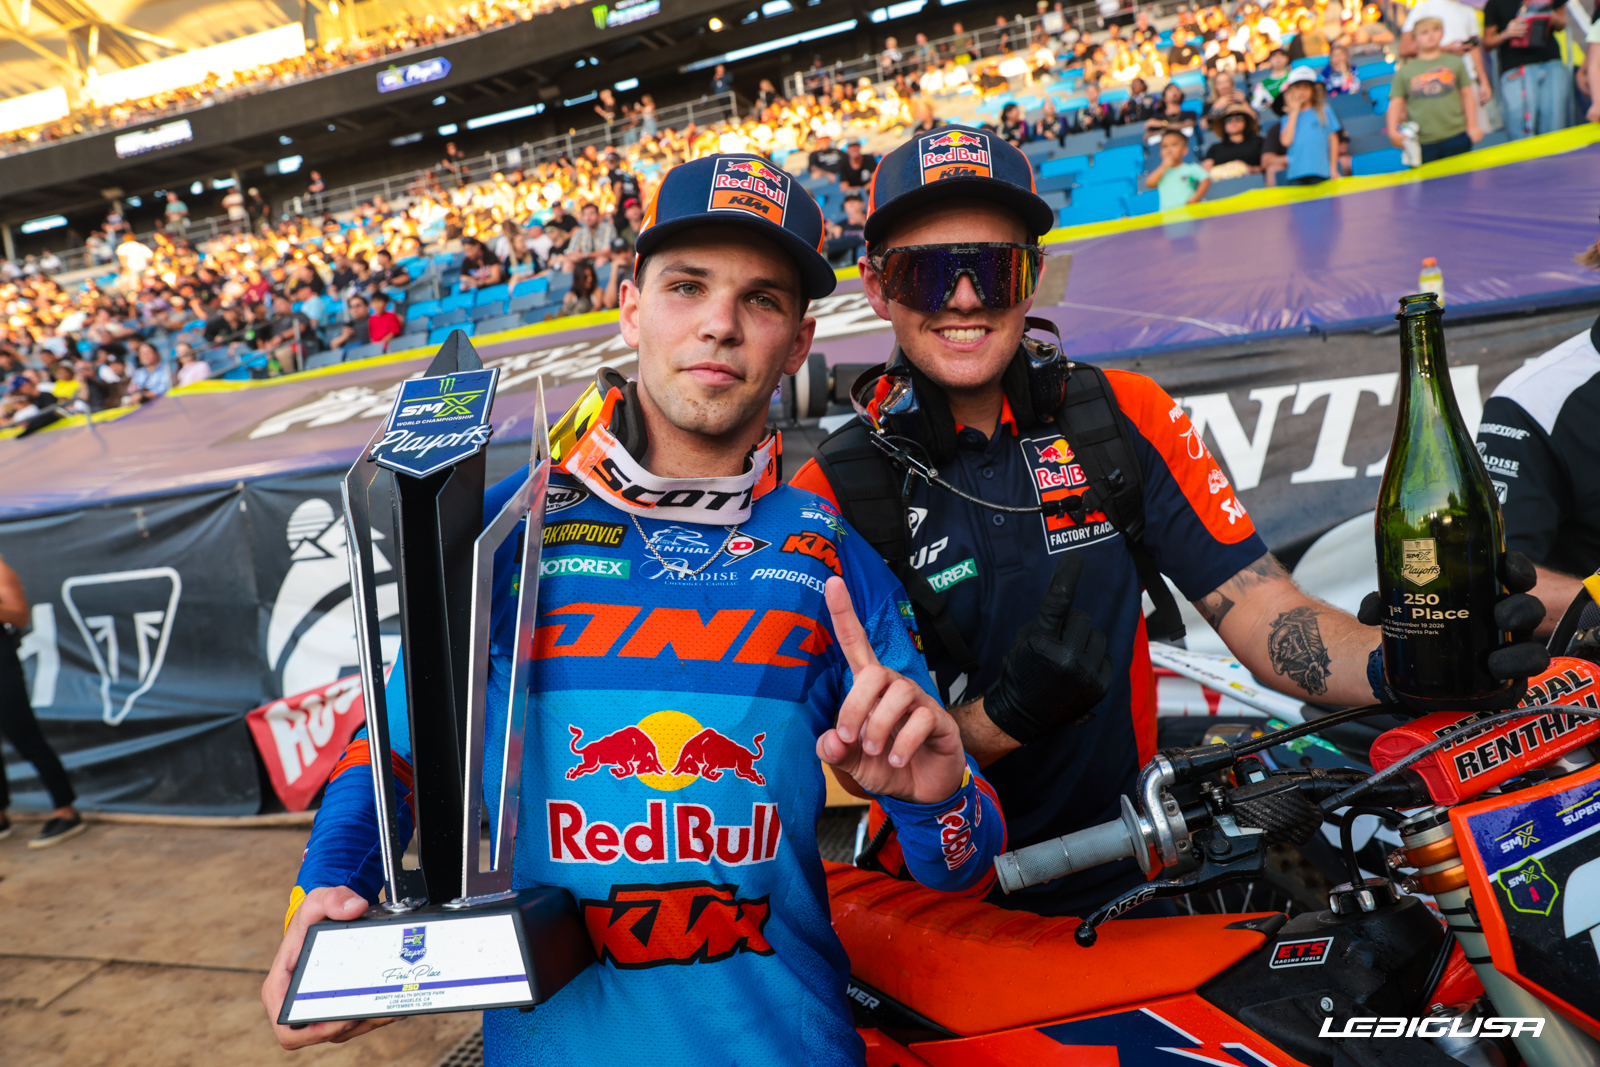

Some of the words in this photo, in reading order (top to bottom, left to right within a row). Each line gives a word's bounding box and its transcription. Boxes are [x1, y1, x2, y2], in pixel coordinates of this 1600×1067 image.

[923, 147, 956, 168] Red
[957, 147, 989, 166] Bull
[939, 166, 977, 178] KTM
[715, 174, 755, 191] Red
[753, 178, 786, 207] Bull
[728, 194, 770, 214] KTM
[398, 394, 482, 417] SMX
[396, 419, 421, 427] WORLD
[421, 414, 475, 425] CHAMPIONSHIP
[370, 425, 492, 459] Playoffs
[589, 457, 755, 511] SCOTT
[1034, 465, 1071, 489] Red
[1050, 526, 1090, 547] FACTORY
[780, 530, 843, 577] KTM
[1403, 563, 1440, 578] Playoffs
[1403, 593, 1440, 606] 250
[1388, 604, 1403, 617] 1st
[1411, 607, 1470, 620] Place
[934, 796, 971, 845] Red
[547, 799, 669, 865] Red
[673, 802, 783, 867] Bull
[1500, 825, 1542, 854] SMX
[942, 828, 978, 871] Bull
[1507, 865, 1541, 889] SMX
[1101, 887, 1156, 924] ARC
[580, 880, 776, 970] KTM
[1274, 957, 1300, 965] RACING
[1277, 941, 1327, 959] ETS
[382, 966, 412, 984] First
[412, 964, 441, 981] Place
[402, 983, 419, 992] 250
